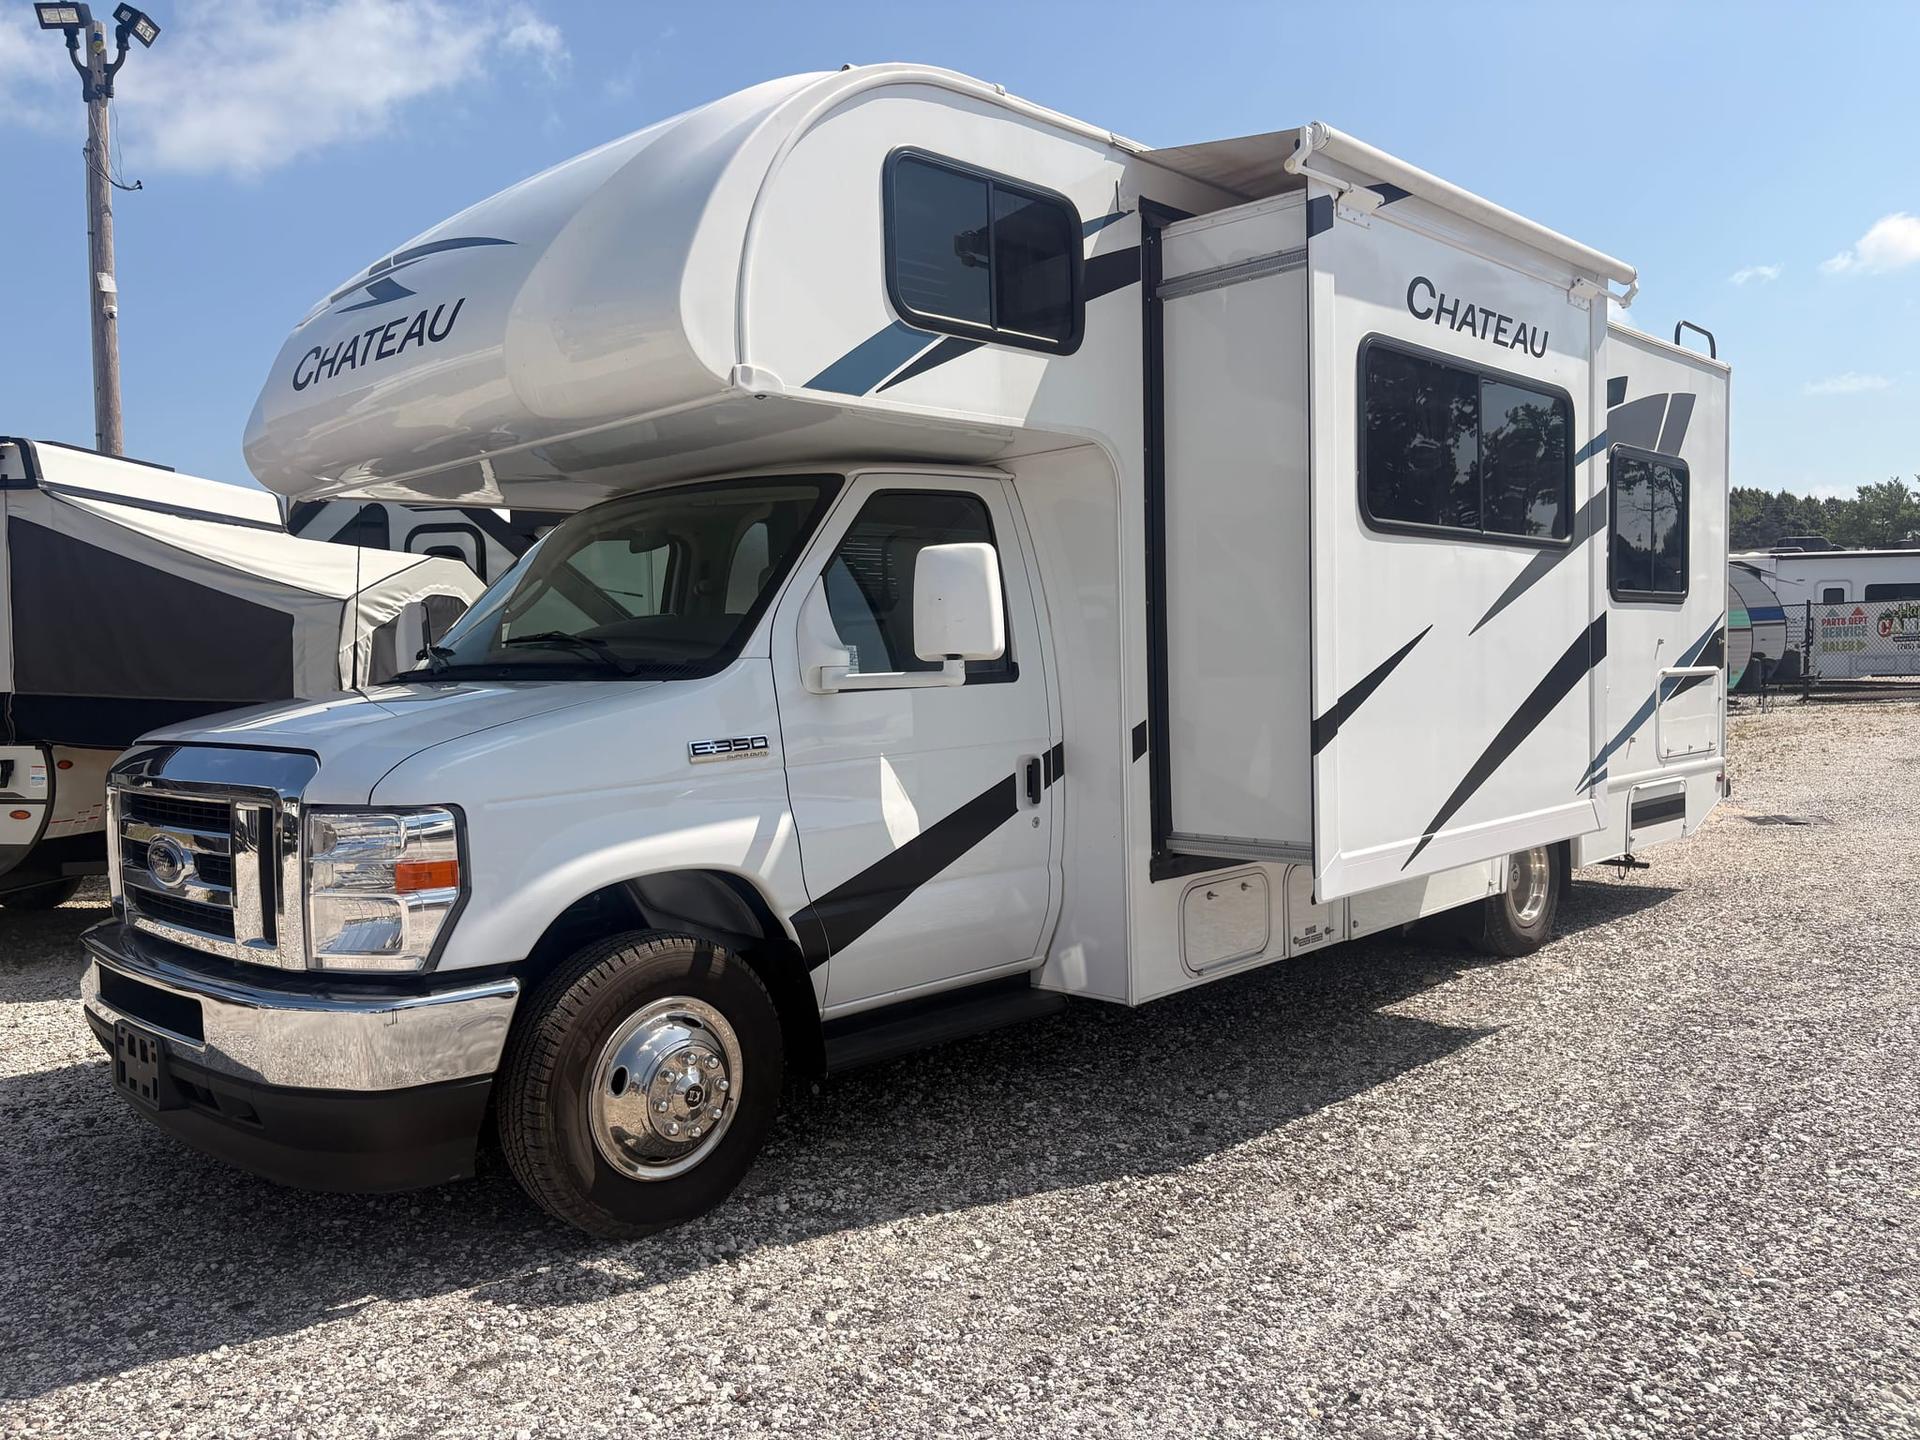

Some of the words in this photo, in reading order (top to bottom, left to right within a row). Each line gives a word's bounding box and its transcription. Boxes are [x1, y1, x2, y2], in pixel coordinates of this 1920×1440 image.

[1406, 276, 1549, 359] CHATEAU
[292, 297, 466, 392] CHATEAU
[1821, 617, 1847, 626] PARTS
[1848, 616, 1868, 625] DEPT
[1822, 626, 1867, 638] SERVICE
